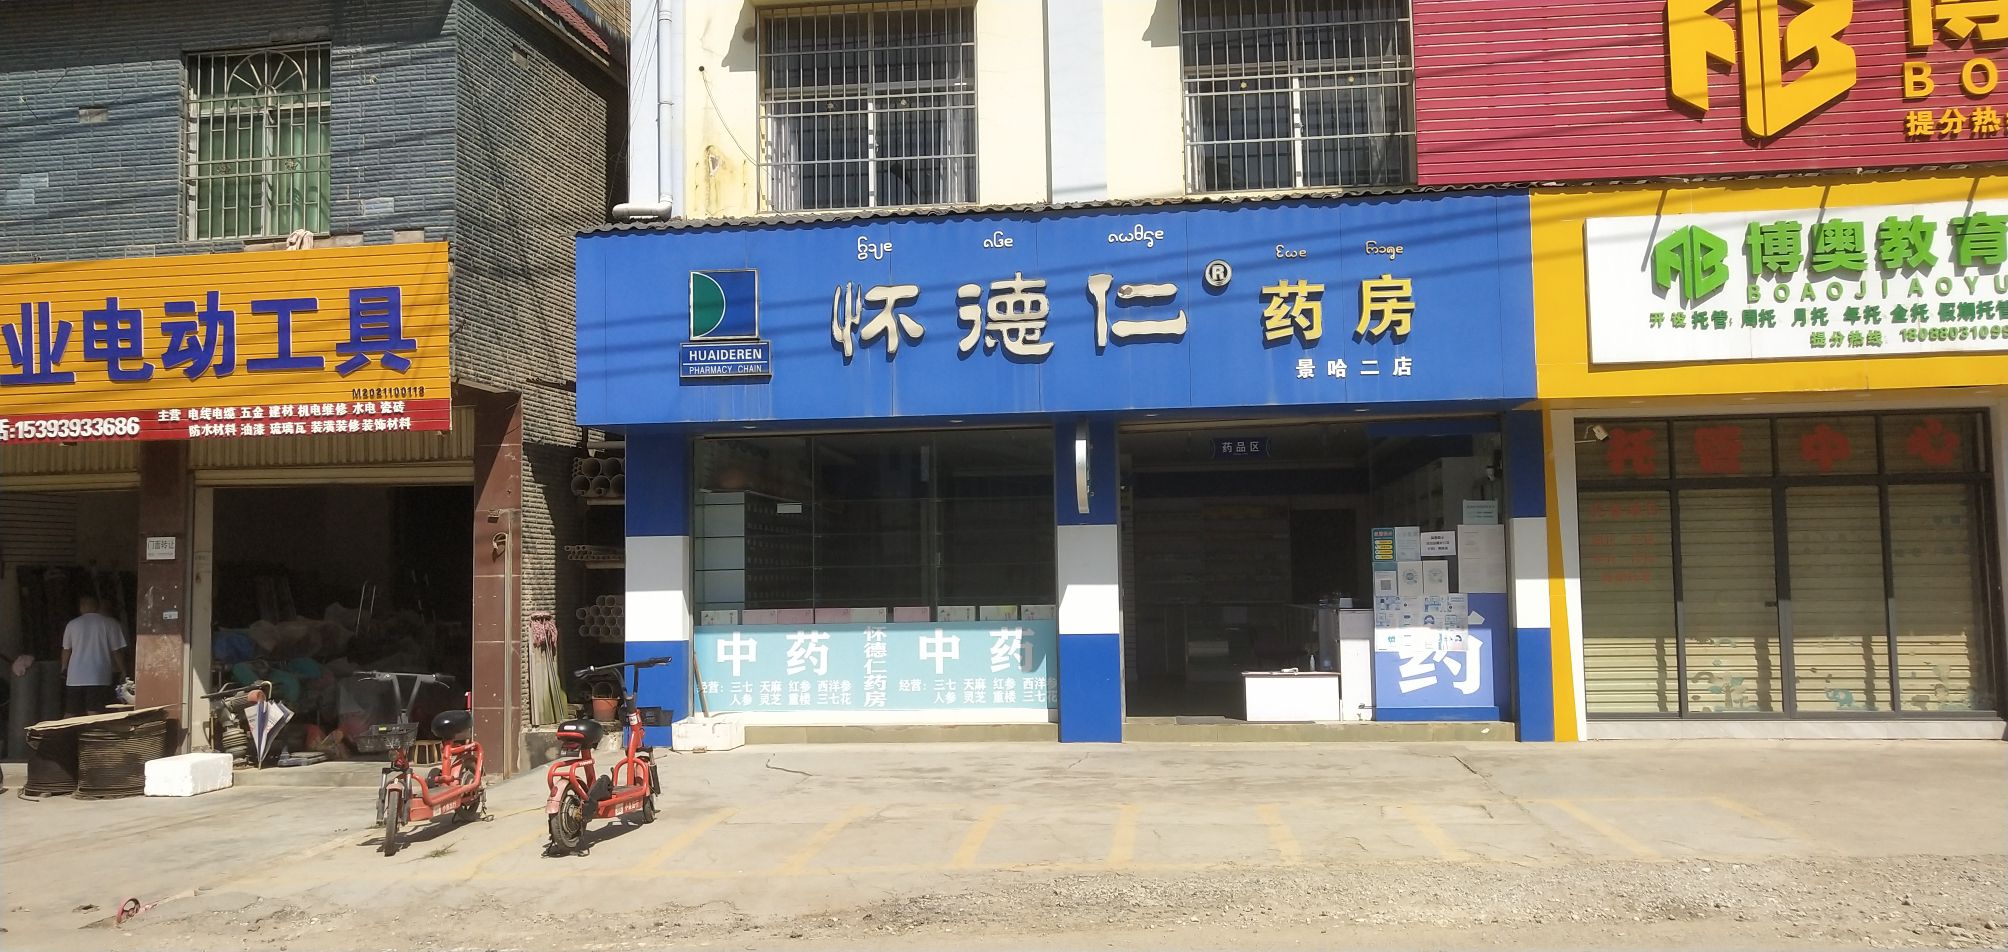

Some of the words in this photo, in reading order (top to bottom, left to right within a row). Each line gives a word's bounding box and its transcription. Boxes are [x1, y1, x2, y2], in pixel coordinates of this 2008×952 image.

[1906, 105, 2008, 137] 提分热
[1747, 211, 2008, 275] 博奥教育
[831, 271, 1188, 357] 怀德仁
[1262, 274, 1415, 341] 药房
[0, 286, 418, 385] 业电动工具
[689, 348, 762, 361] HUAIDEREN
[689, 365, 733, 375] PHARMACY
[737, 364, 762, 374] CHAIN
[1296, 357, 1412, 379] 景哈二店
[158, 409, 181, 421] 主营
[188, 407, 236, 421] 电线电缆
[241, 406, 265, 419] 五金
[269, 404, 295, 418] 建材
[298, 403, 348, 417] 机电维修
[352, 402, 377, 415] 水电
[380, 401, 405, 414] 瓷砖
[188, 424, 238, 437] 防水材料
[241, 423, 265, 436] 油漆
[270, 421, 307, 435] 琉璃瓦
[1222, 441, 1260, 453] 药品区
[716, 631, 832, 677] 中药
[919, 626, 1035, 675] 中药
[864, 626, 888, 708] 怀德仁药房
[730, 680, 753, 693] 三七
[760, 680, 784, 693] 天麻
[788, 680, 812, 693] 红参
[817, 679, 852, 693] 西洋参
[934, 679, 957, 691] 三七
[963, 678, 987, 691] 天麻
[993, 678, 1017, 691] 红参
[729, 693, 753, 706] 人参
[760, 693, 782, 706] 灵芝
[817, 693, 852, 706] 三七花
[934, 692, 957, 704] 人参
[963, 691, 986, 704] 灵芝
